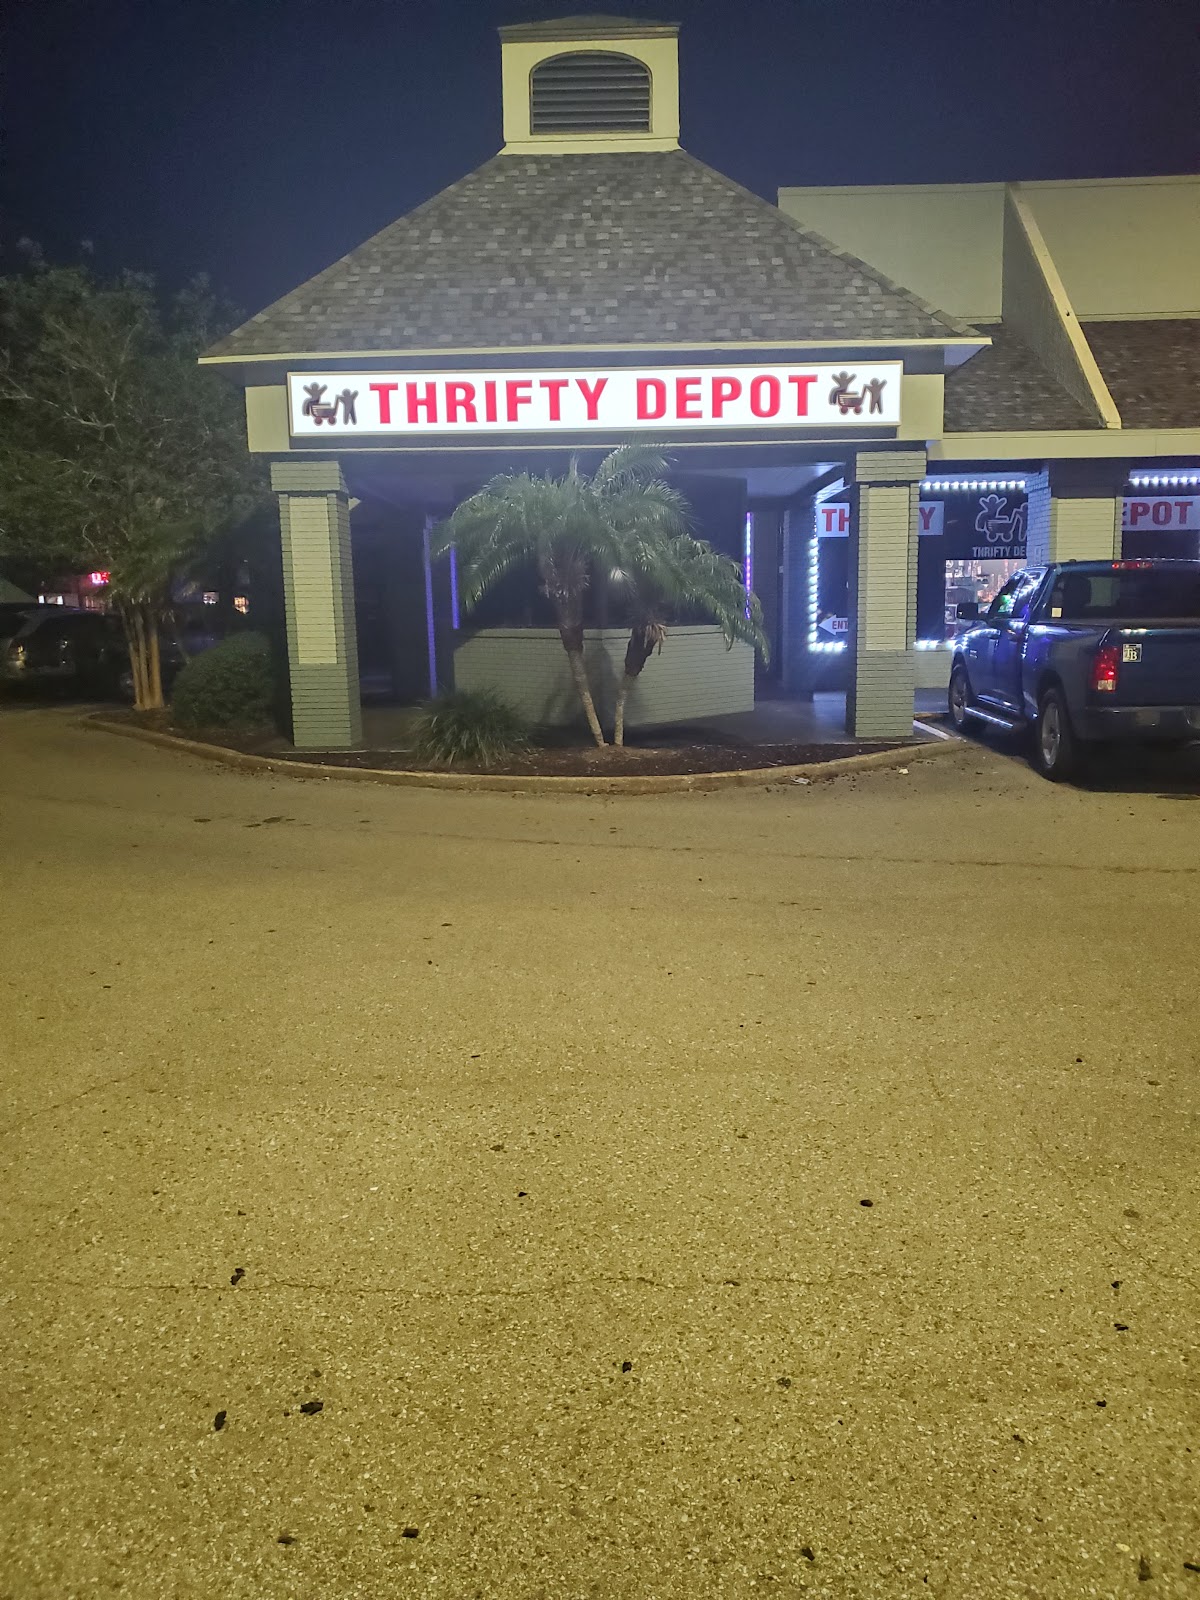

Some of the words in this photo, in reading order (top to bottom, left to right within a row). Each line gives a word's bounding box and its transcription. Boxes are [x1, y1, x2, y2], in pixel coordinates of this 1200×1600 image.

[369, 377, 609, 424] THRIFTY
[636, 374, 818, 420] DEPOT
[972, 545, 1011, 558] THRIFTY
